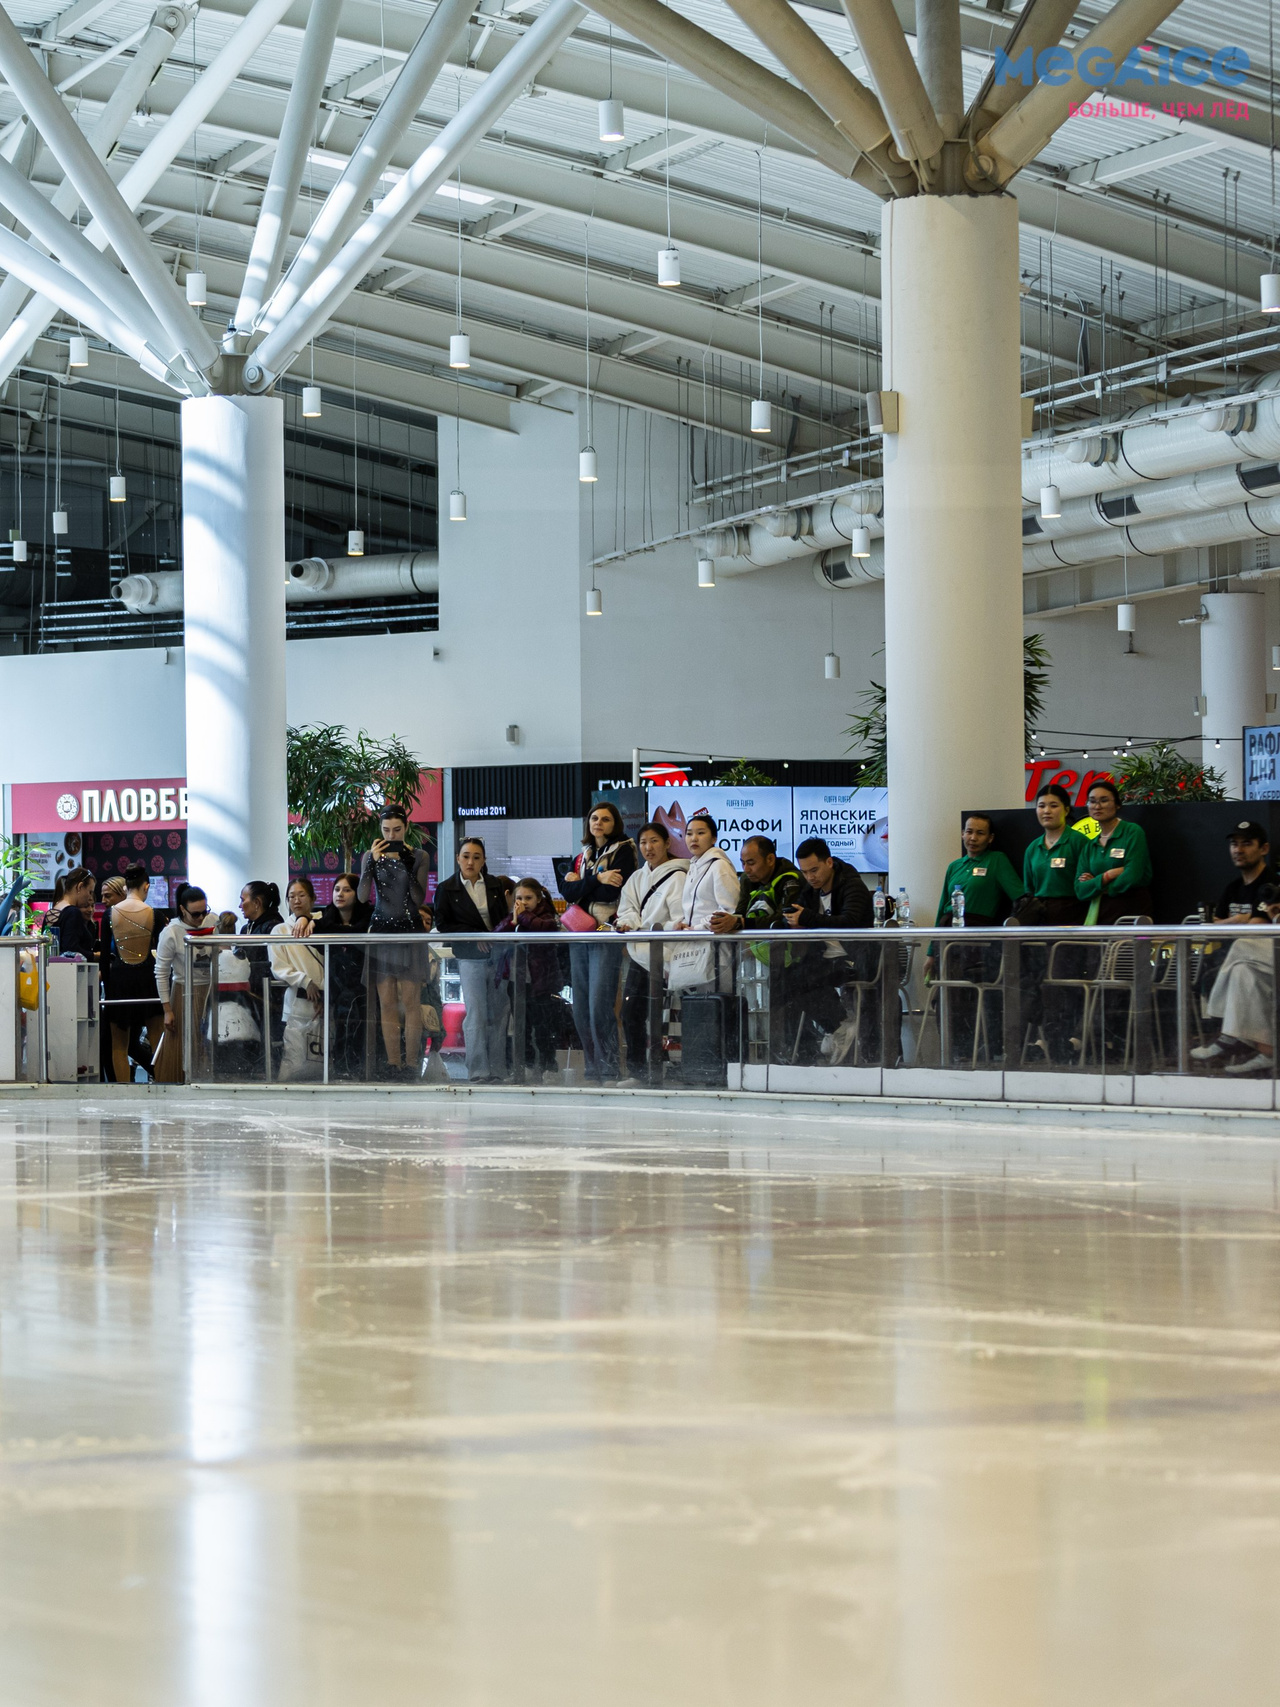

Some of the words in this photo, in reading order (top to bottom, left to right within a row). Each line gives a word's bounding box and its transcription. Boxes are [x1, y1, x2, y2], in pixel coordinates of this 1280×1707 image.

[1249, 758, 1276, 785] ДНЯ
[458, 807, 488, 816] founded
[489, 806, 506, 816] 2011
[800, 809, 877, 821] ЯПОНСКИЕ
[717, 818, 782, 832] ЛАФФИ
[800, 821, 876, 835] ПАНКЕЙКИ
